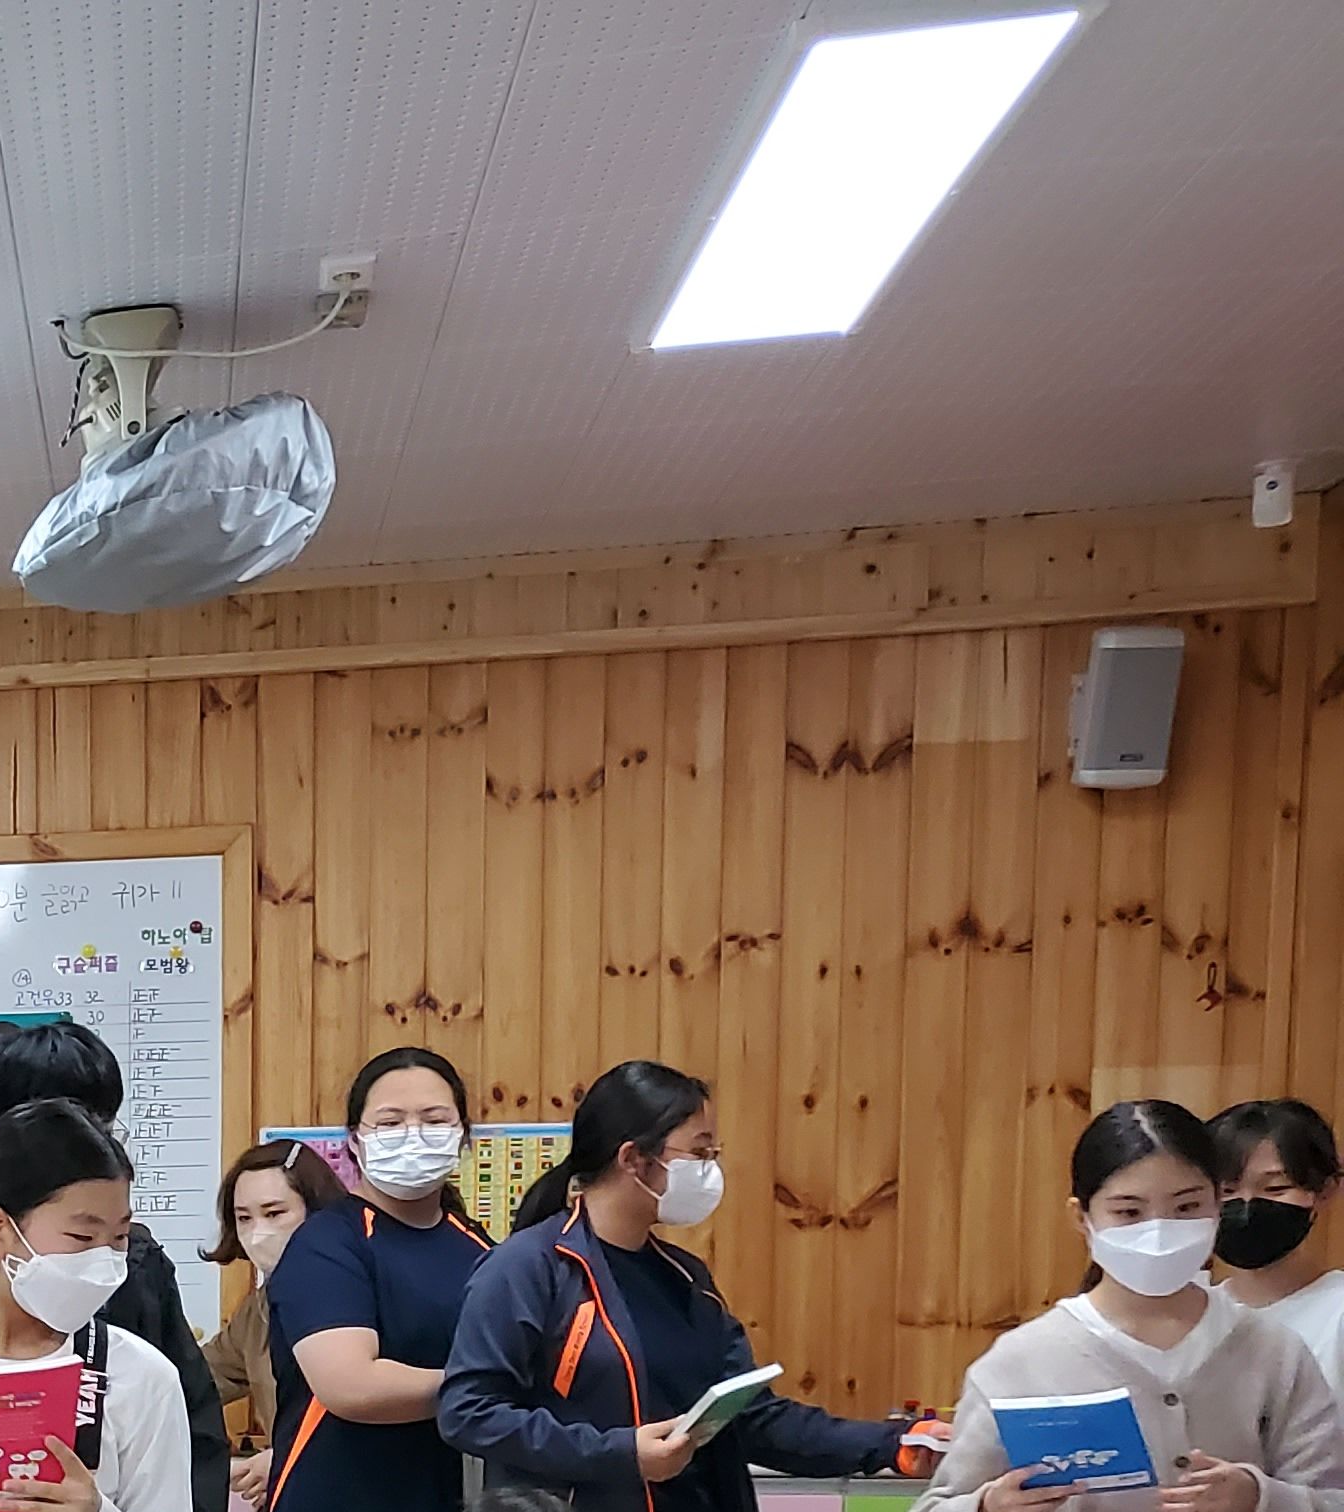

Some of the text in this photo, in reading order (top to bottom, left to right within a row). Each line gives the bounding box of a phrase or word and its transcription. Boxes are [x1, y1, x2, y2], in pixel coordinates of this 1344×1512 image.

[112, 881, 160, 909] 귀가
[144, 957, 190, 975] 모범왕
[86, 1010, 105, 1025] 30
